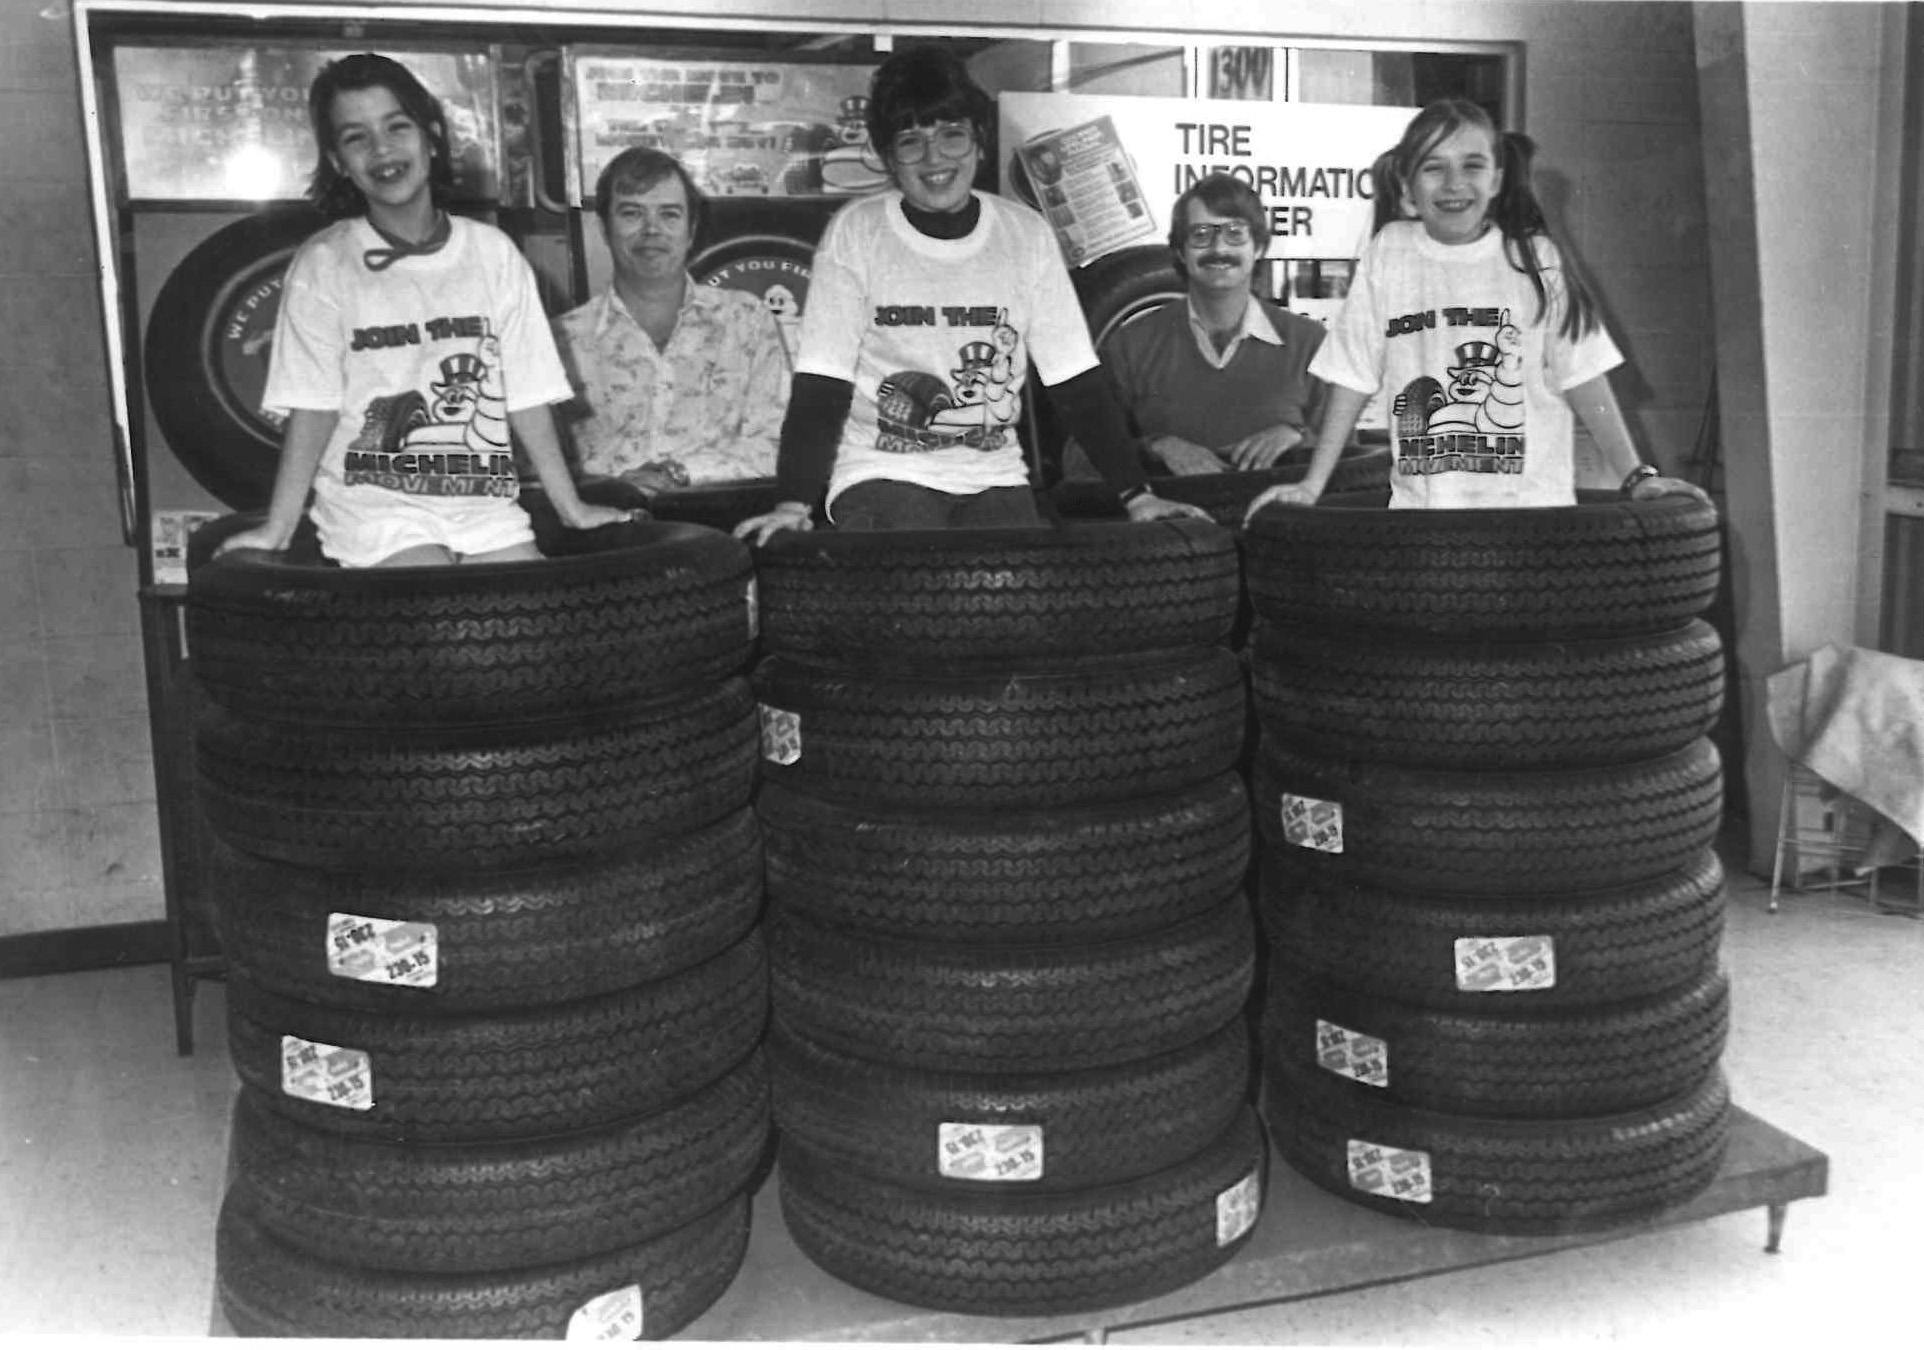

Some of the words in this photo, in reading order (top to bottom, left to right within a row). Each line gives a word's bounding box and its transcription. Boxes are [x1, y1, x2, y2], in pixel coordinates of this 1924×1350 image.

[1175, 123, 1251, 156] TIRE
[1264, 206, 1312, 236] ER
[707, 270, 730, 287] UT
[735, 260, 775, 272] YOU
[246, 279, 281, 309] PUT
[874, 306, 936, 327] JOIN
[941, 306, 998, 327] THE
[1385, 310, 1436, 338] JON
[1442, 307, 1499, 327] THE
[351, 323, 421, 351] JOIN
[425, 316, 483, 341] THE
[344, 451, 514, 476] MICHELIN
